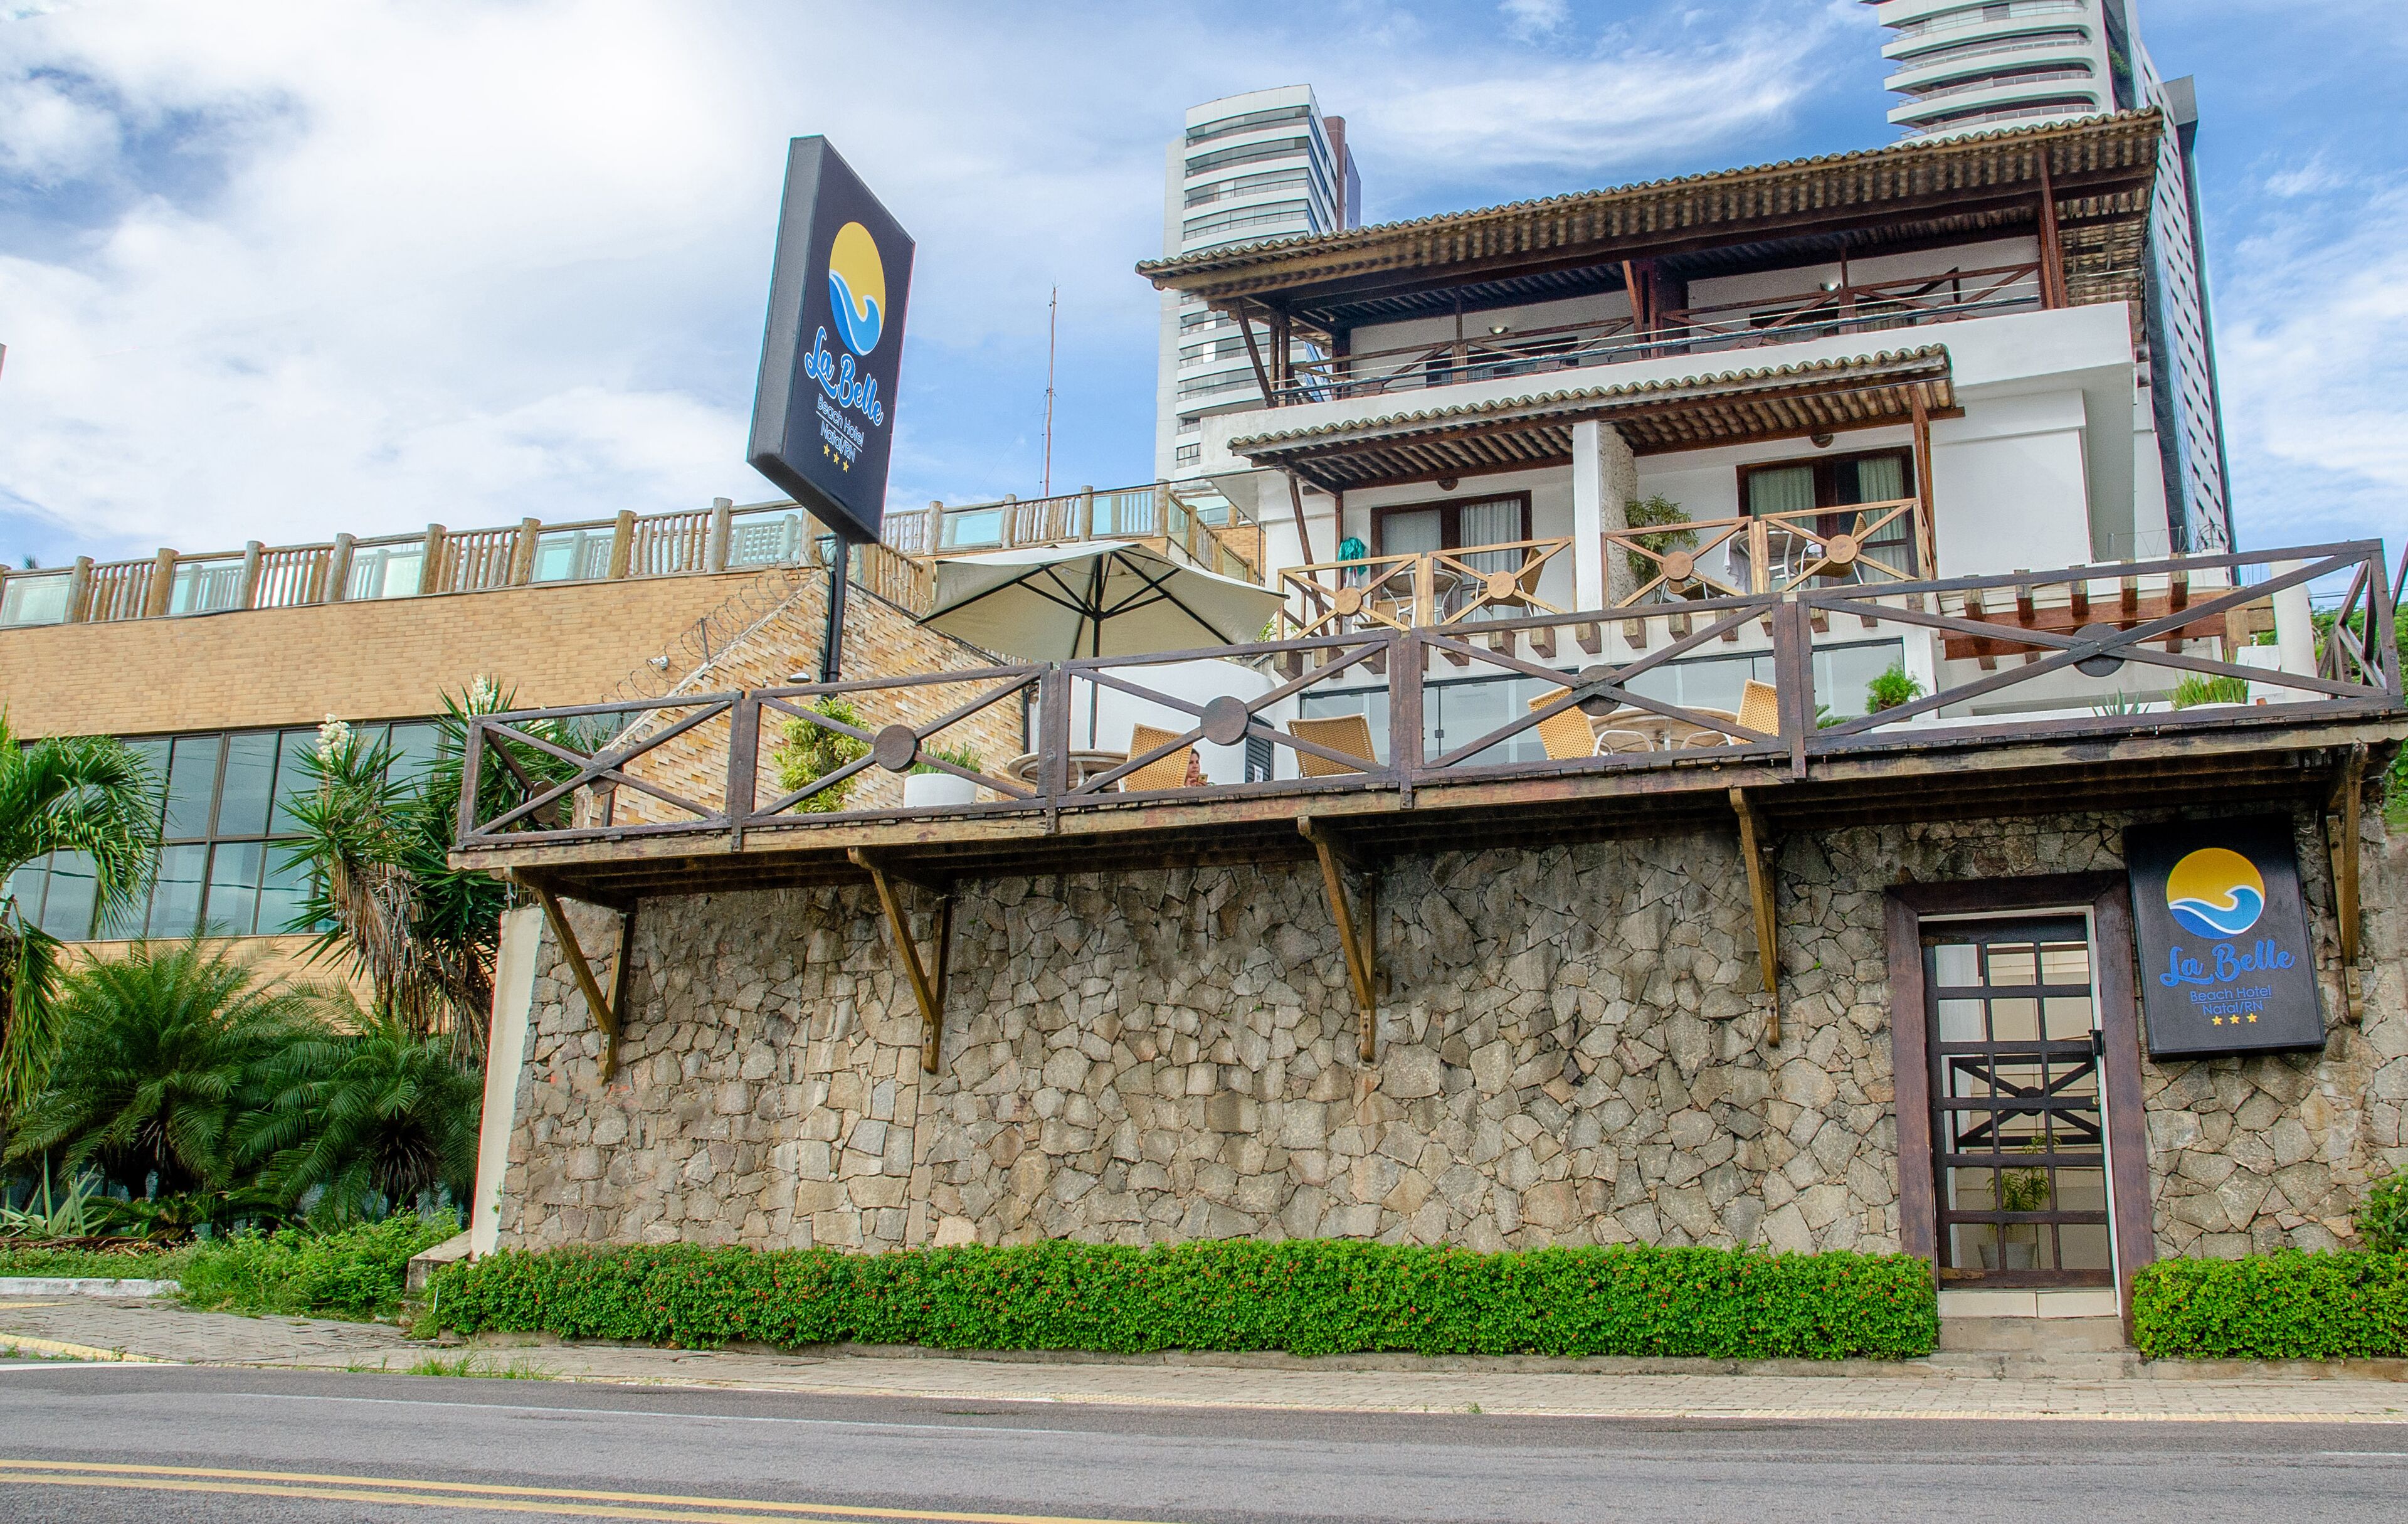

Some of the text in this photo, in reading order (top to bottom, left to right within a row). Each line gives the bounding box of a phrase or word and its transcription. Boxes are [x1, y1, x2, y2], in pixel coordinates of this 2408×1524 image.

[804, 325, 884, 426] La Belle
[817, 393, 864, 447] Beach Hotel
[820, 420, 856, 463] Natal/RN
[2159, 939, 2296, 987] La Belle
[2189, 985, 2272, 1002] Beach Hotel
[2202, 1000, 2264, 1015] Natal/RN
